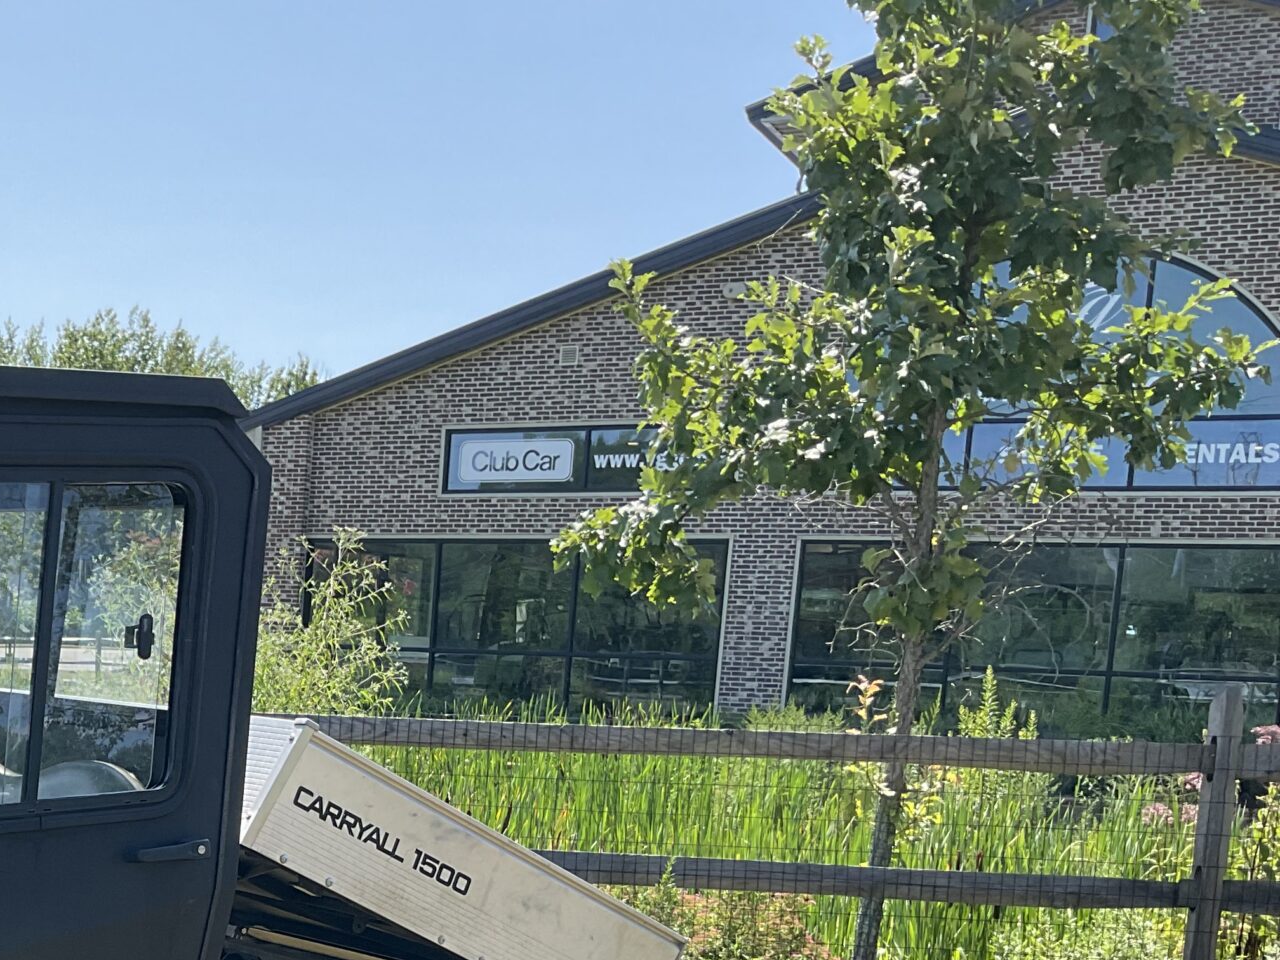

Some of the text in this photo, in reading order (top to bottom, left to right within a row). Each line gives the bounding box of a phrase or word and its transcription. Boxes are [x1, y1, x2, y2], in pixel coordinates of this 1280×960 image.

[471, 449, 560, 472] Club Car
[1176, 442, 1280, 464] ENTALS
[293, 785, 472, 896] CARRYALL 1500
